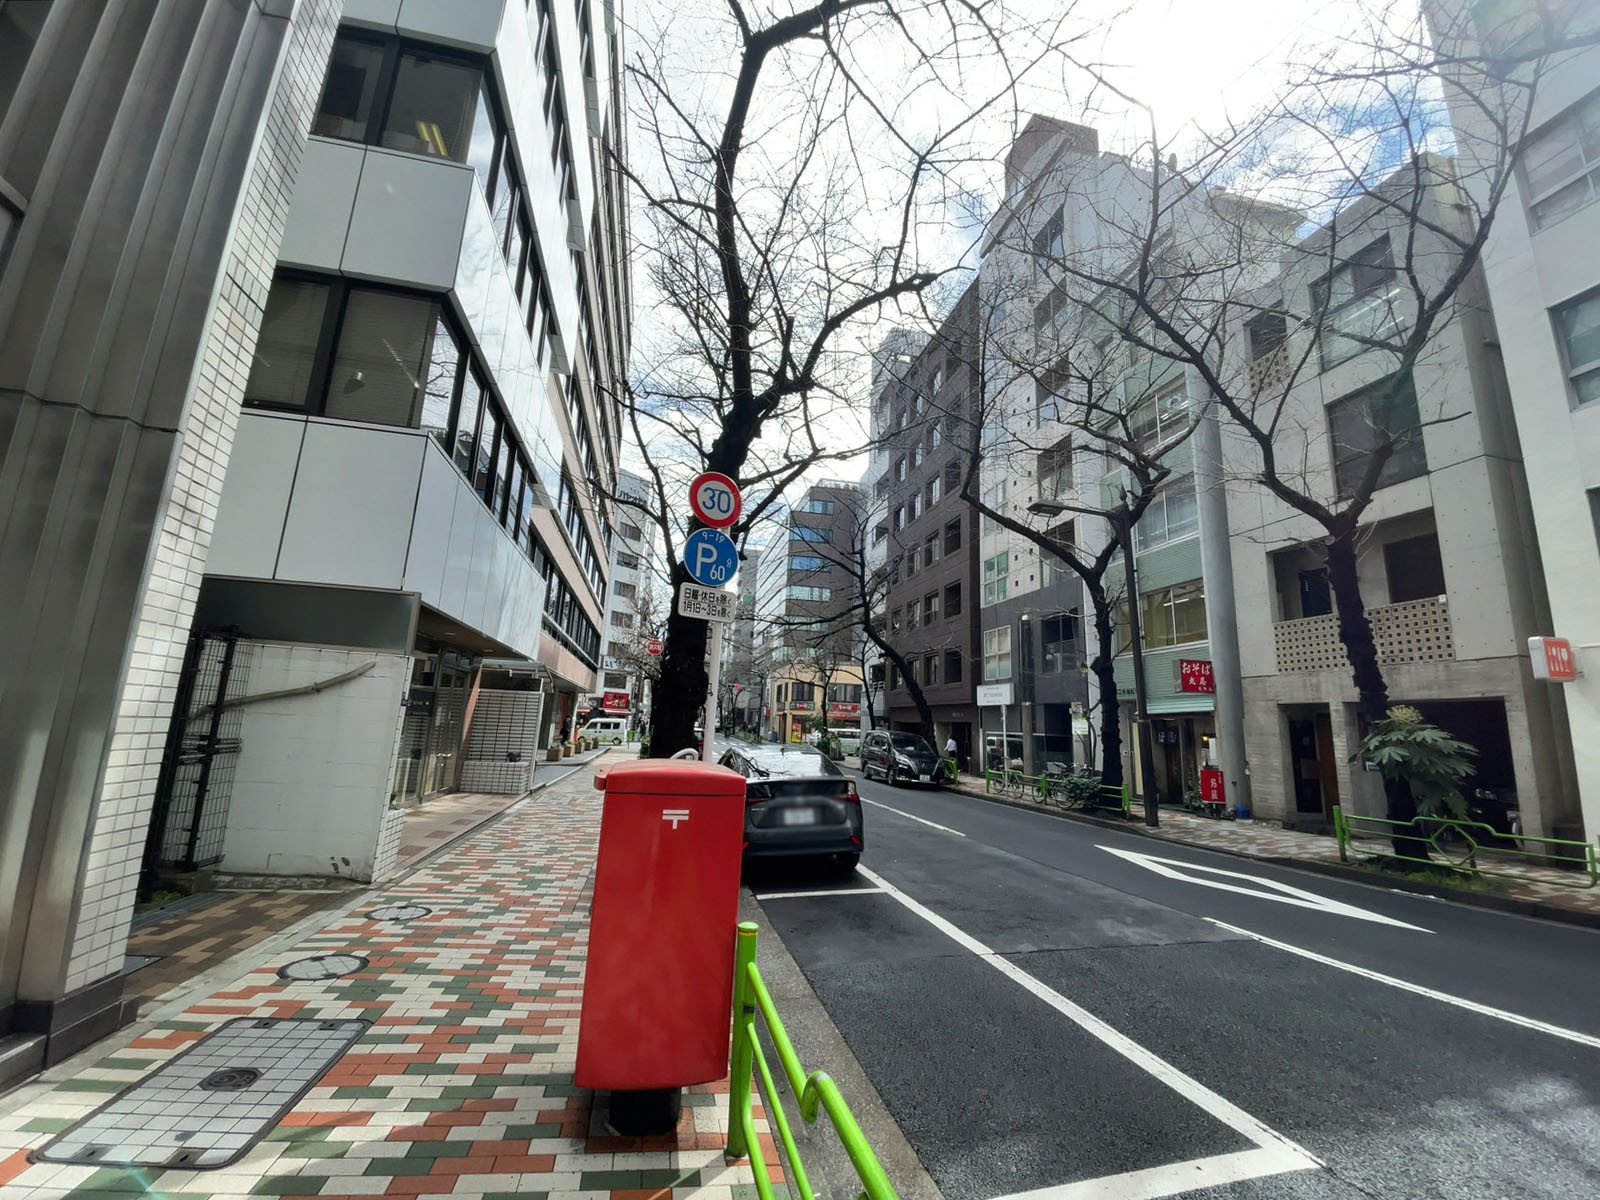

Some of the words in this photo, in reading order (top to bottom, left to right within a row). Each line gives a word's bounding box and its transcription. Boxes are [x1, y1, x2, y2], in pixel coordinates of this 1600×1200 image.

[702, 487, 730, 513] 30
[702, 531, 725, 543] 9-19
[695, 542, 718, 577] P
[1182, 662, 1211, 675] おそば
